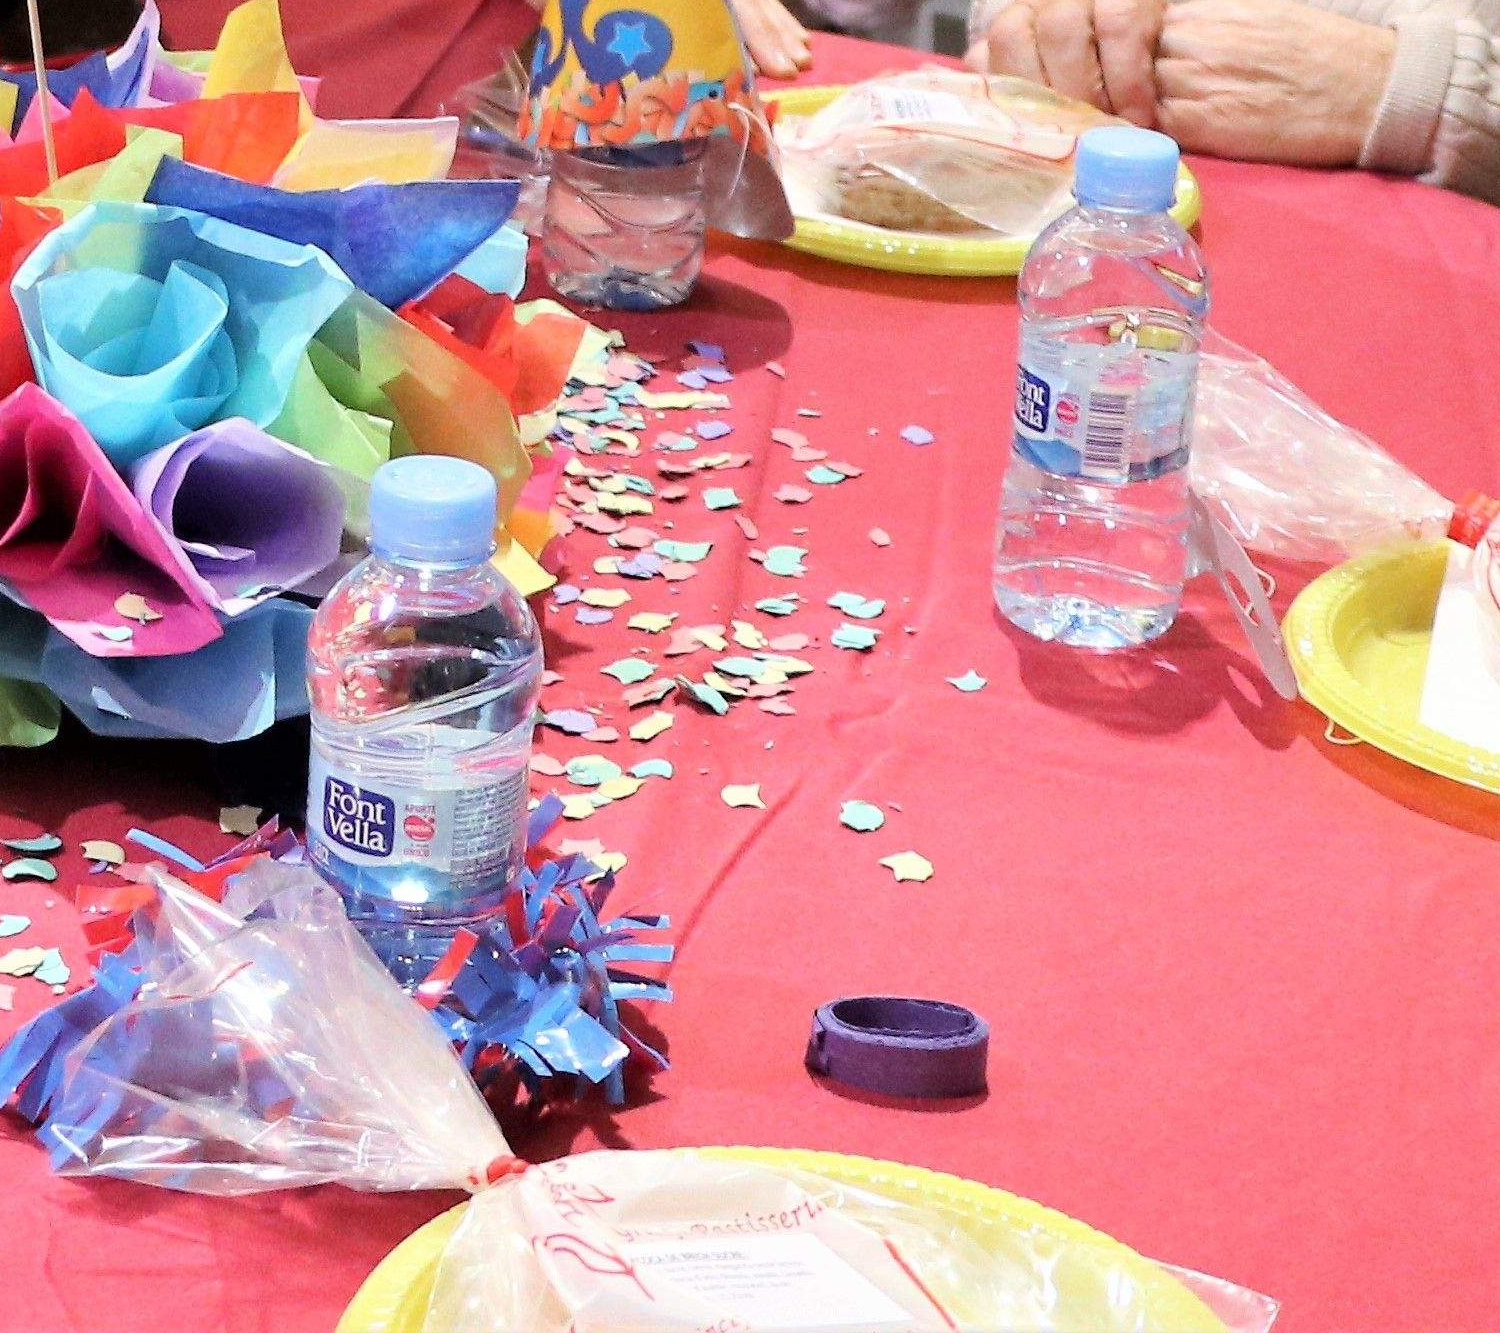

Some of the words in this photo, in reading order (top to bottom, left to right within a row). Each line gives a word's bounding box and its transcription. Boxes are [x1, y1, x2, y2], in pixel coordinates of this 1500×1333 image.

[1017, 375, 1046, 406] ont
[329, 780, 387, 826] Font
[326, 806, 387, 853] Vella
